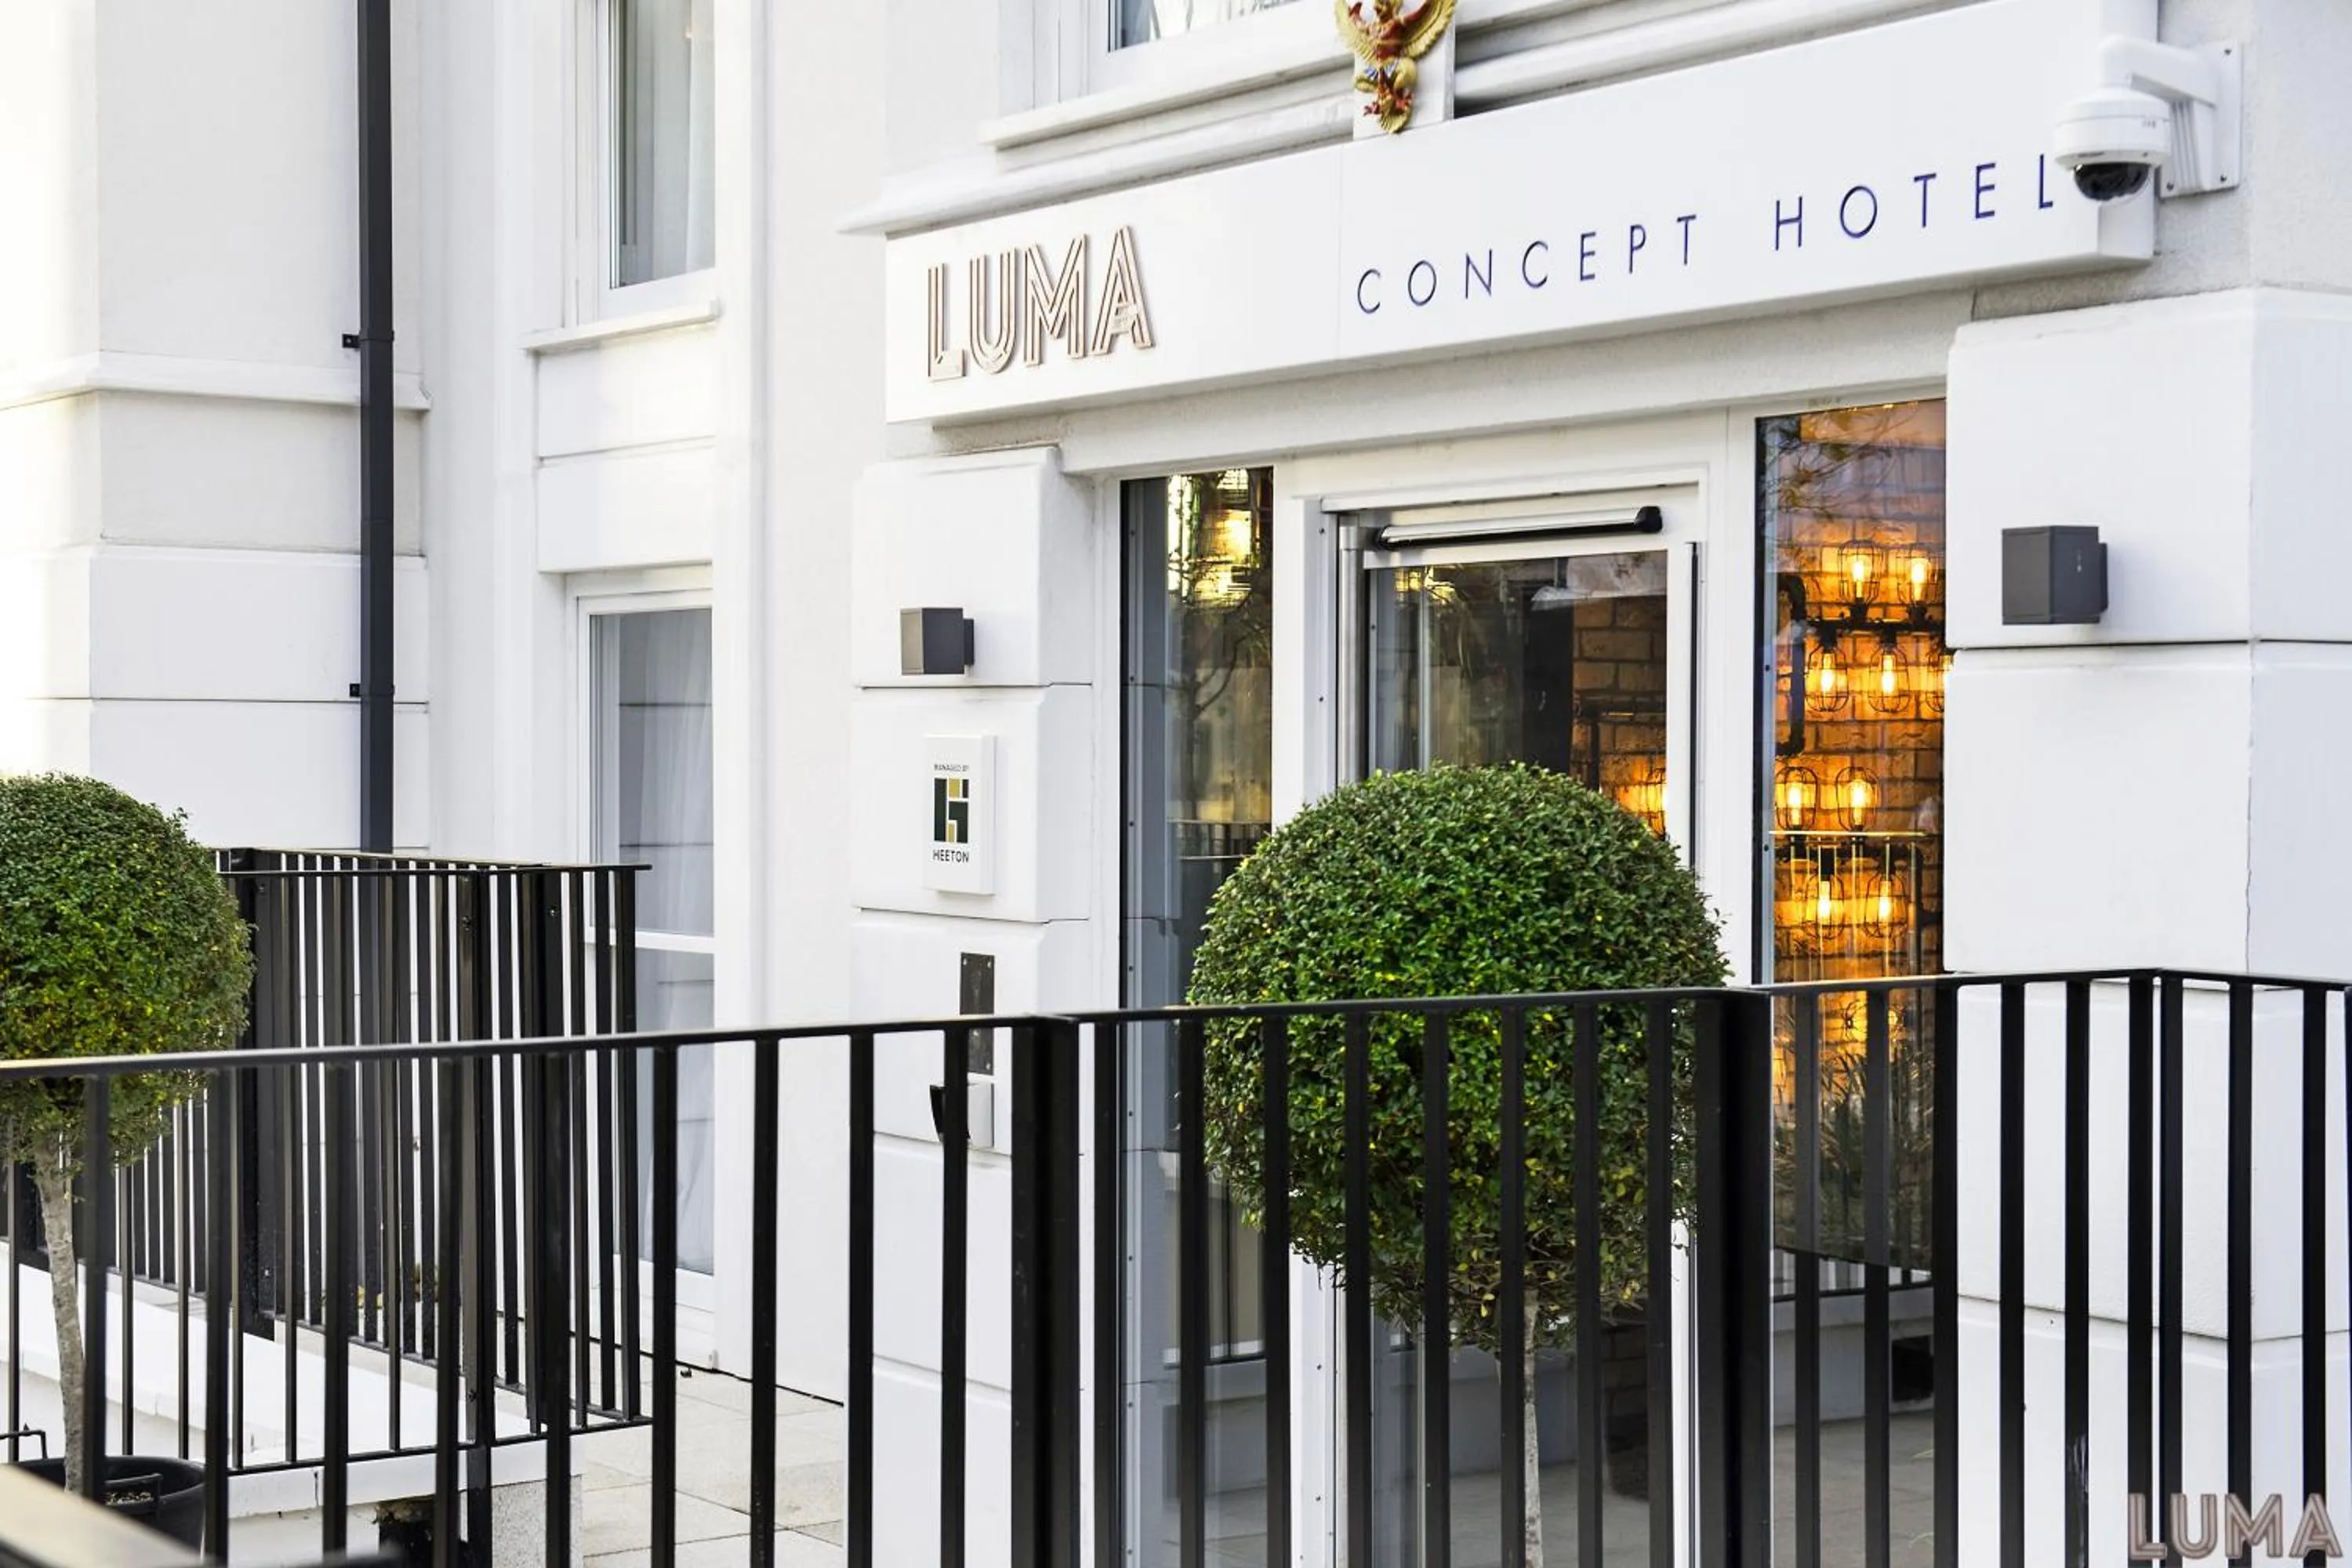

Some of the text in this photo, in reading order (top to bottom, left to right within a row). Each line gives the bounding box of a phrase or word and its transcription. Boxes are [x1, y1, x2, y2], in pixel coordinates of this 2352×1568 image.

[927, 225, 1156, 383] LUMA
[1357, 153, 2053, 314] CONCEPT HOTEL
[932, 849, 970, 863] HEETON
